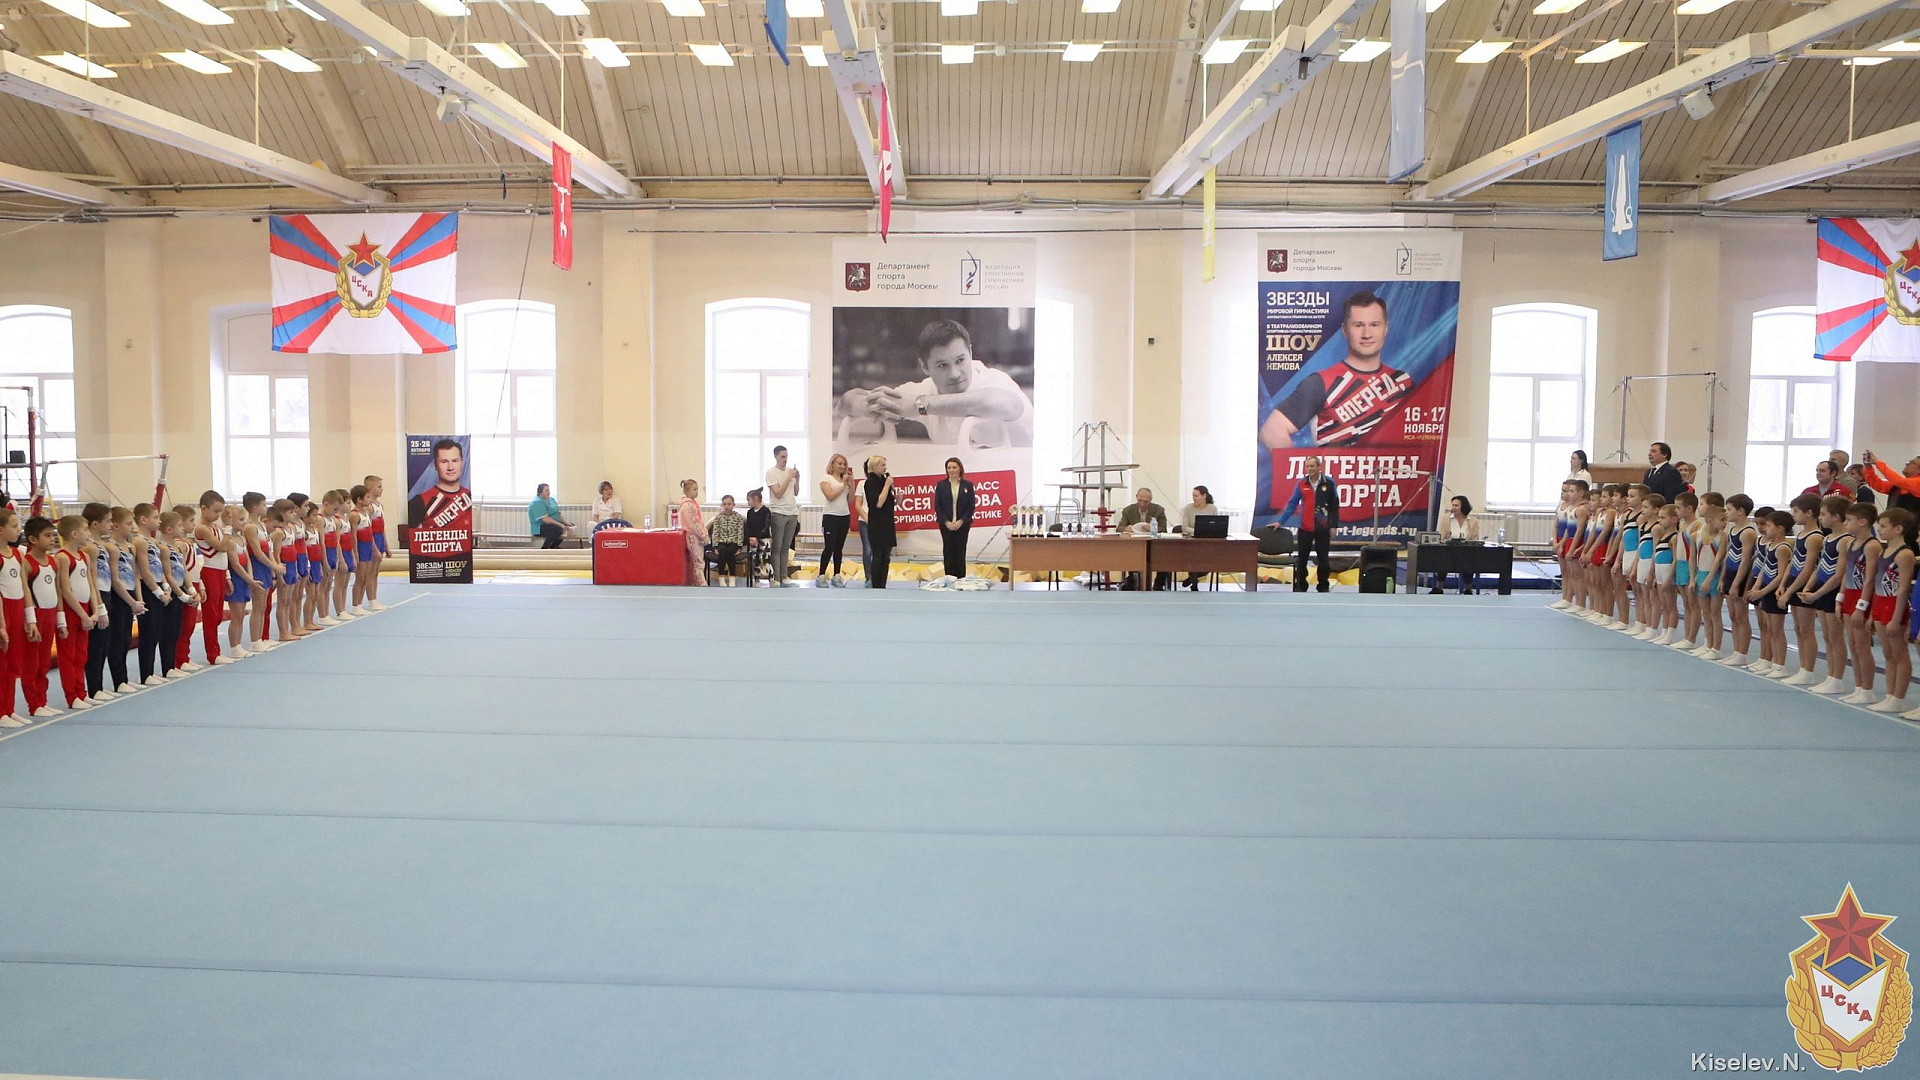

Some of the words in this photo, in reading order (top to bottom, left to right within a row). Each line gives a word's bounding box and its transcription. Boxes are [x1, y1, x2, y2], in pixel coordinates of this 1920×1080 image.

[877, 262, 930, 271] Департамент
[877, 273, 905, 281] спорта
[352, 275, 373, 297] ЦСКА
[877, 283, 906, 292] города
[907, 282, 939, 290] Москвы
[1266, 291, 1330, 308] ЗВЕЗДЫ
[1266, 334, 1321, 351] ШОУ
[1267, 353, 1303, 361] АЛЕКСЕЯ
[1267, 362, 1300, 371] НЕМОВА
[1404, 406, 1420, 422] 16
[1431, 406, 1446, 422] 17
[1404, 423, 1444, 433] НОЯБРЯ
[1286, 455, 1419, 481] ЛГЕНДЫ
[414, 529, 468, 541] ЛЕГЕНДЫ
[421, 541, 463, 553] СПОРТА
[445, 560, 468, 569] ШОУ
